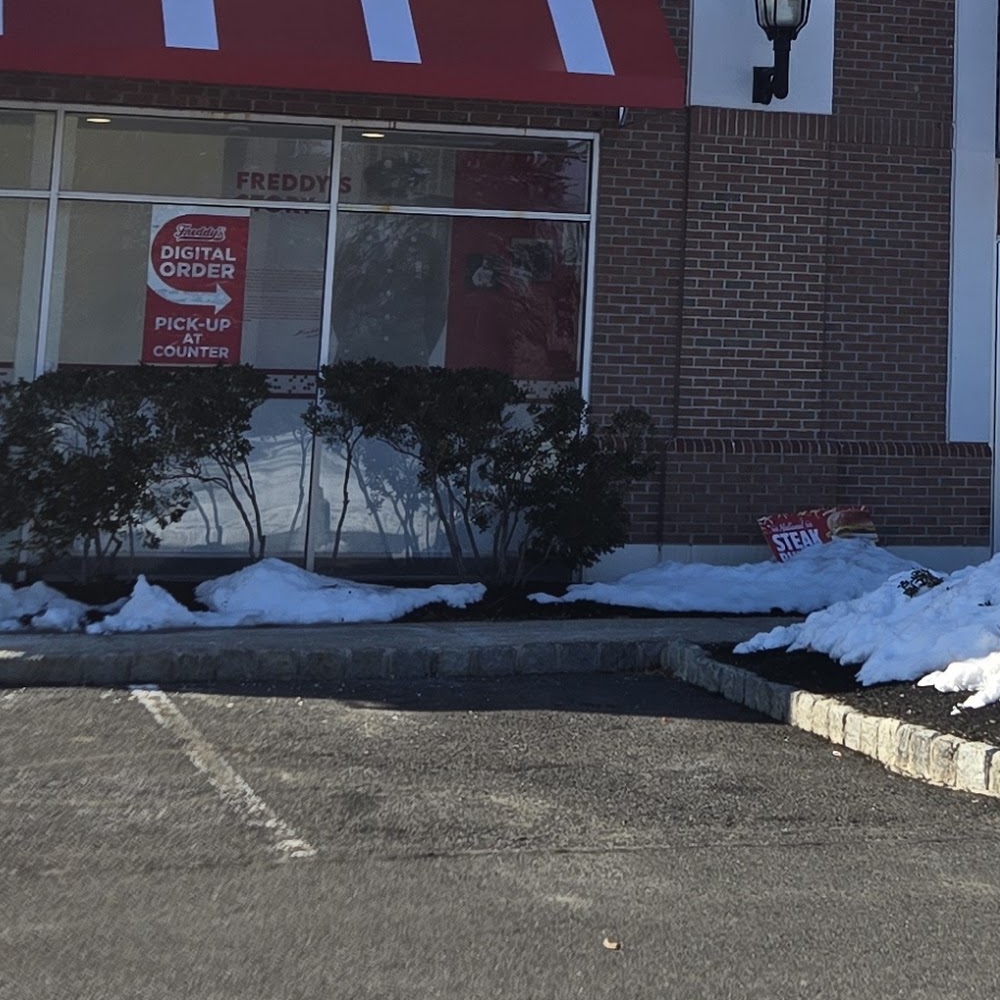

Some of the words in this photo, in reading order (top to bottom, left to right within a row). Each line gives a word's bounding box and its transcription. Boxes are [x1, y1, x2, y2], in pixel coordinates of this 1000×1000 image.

[236, 171, 352, 194] FREDDYS
[173, 223, 226, 242] Freddy's
[160, 245, 236, 262] DIGITAL
[159, 261, 235, 279] ORDER
[154, 316, 231, 332] PICK-UP
[182, 333, 203, 345] AT
[153, 345, 229, 359] COUNTER
